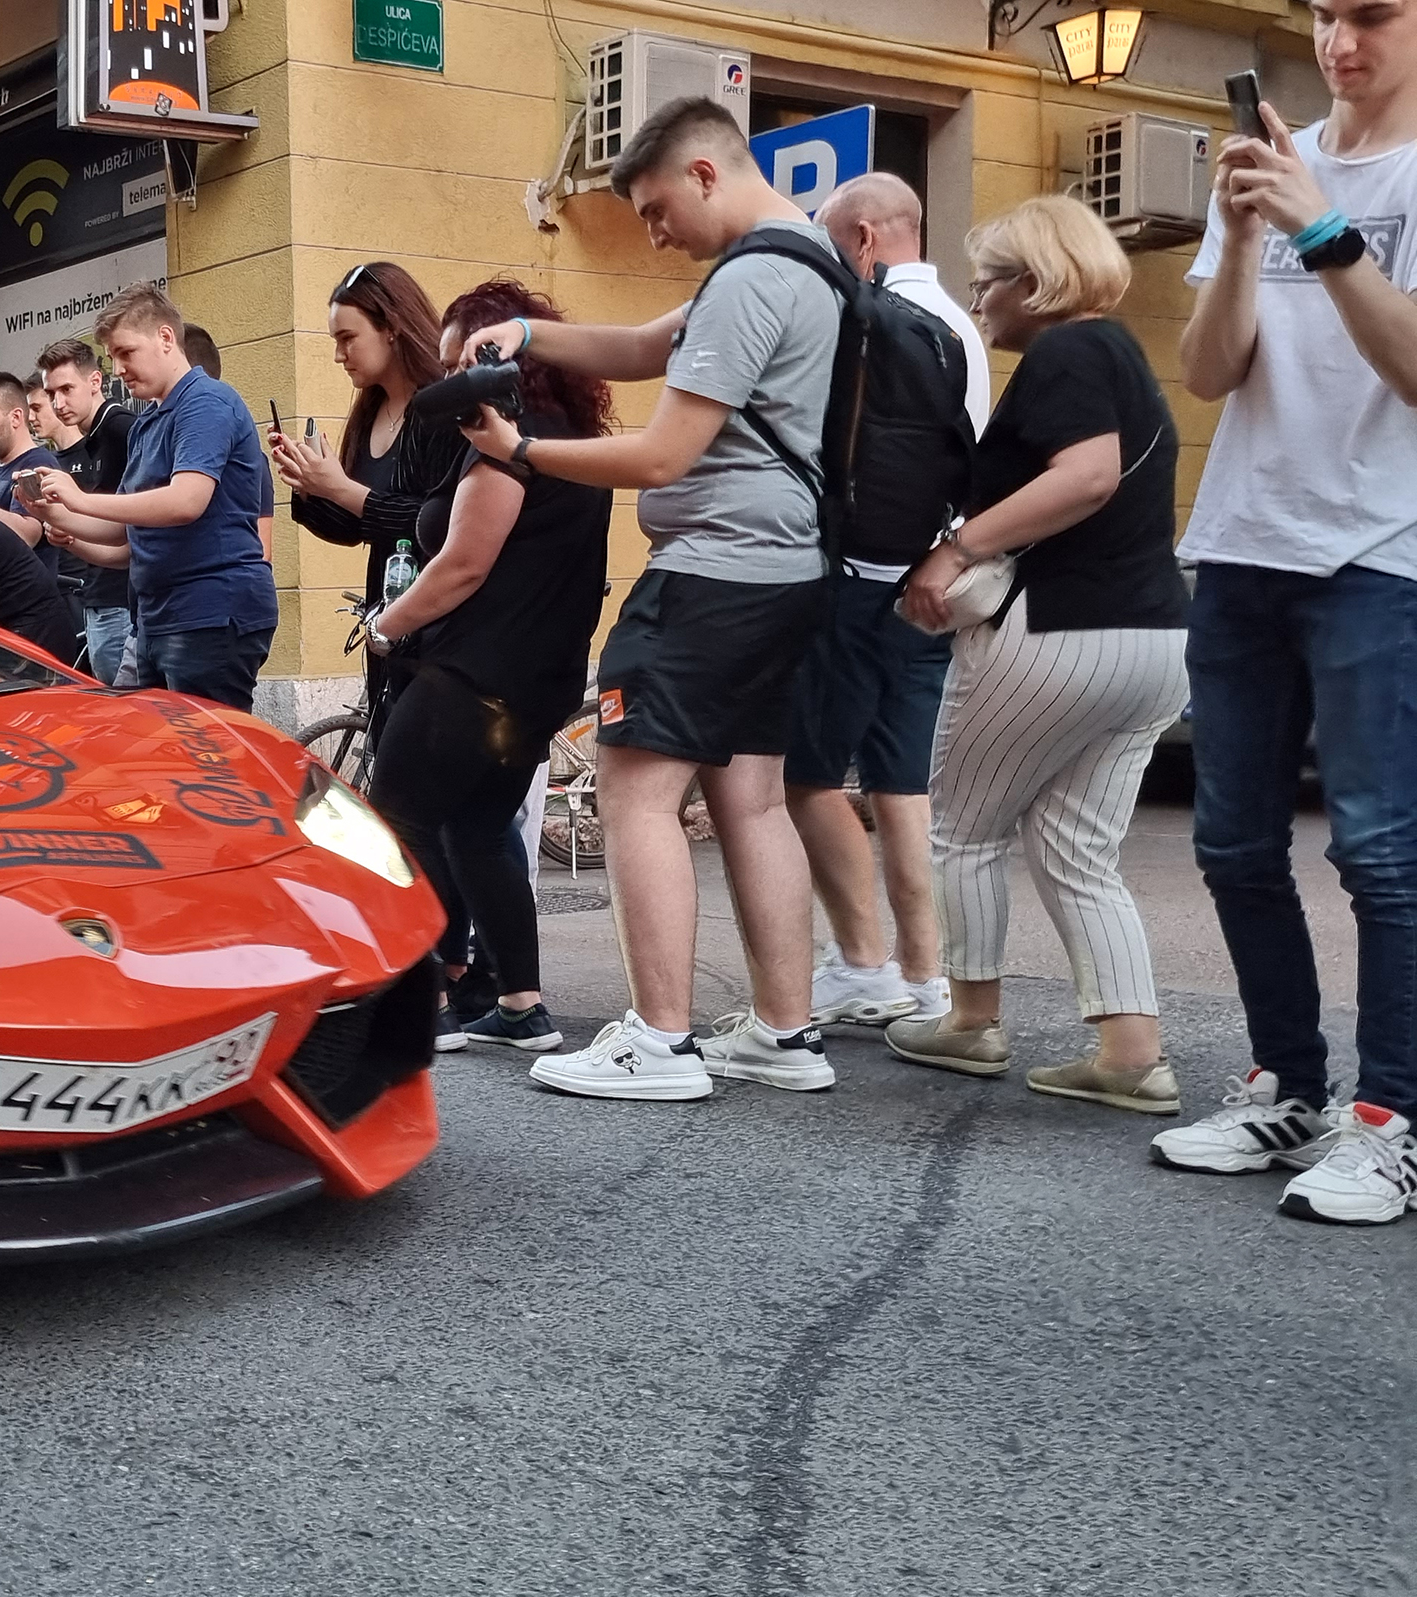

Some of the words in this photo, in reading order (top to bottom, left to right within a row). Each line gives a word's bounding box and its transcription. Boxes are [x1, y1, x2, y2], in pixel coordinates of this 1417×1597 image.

[385, 5, 411, 20] ULICA
[1066, 26, 1092, 43] CITY
[1109, 23, 1132, 34] CITY
[723, 84, 746, 96] GREE
[83, 150, 132, 180] NAJBRŽI
[773, 139, 837, 214] P
[85, 213, 111, 228] POWERED
[112, 211, 119, 221] BY
[5, 311, 33, 333] WIFI
[37, 311, 51, 325] na
[55, 293, 113, 321] najbržem
